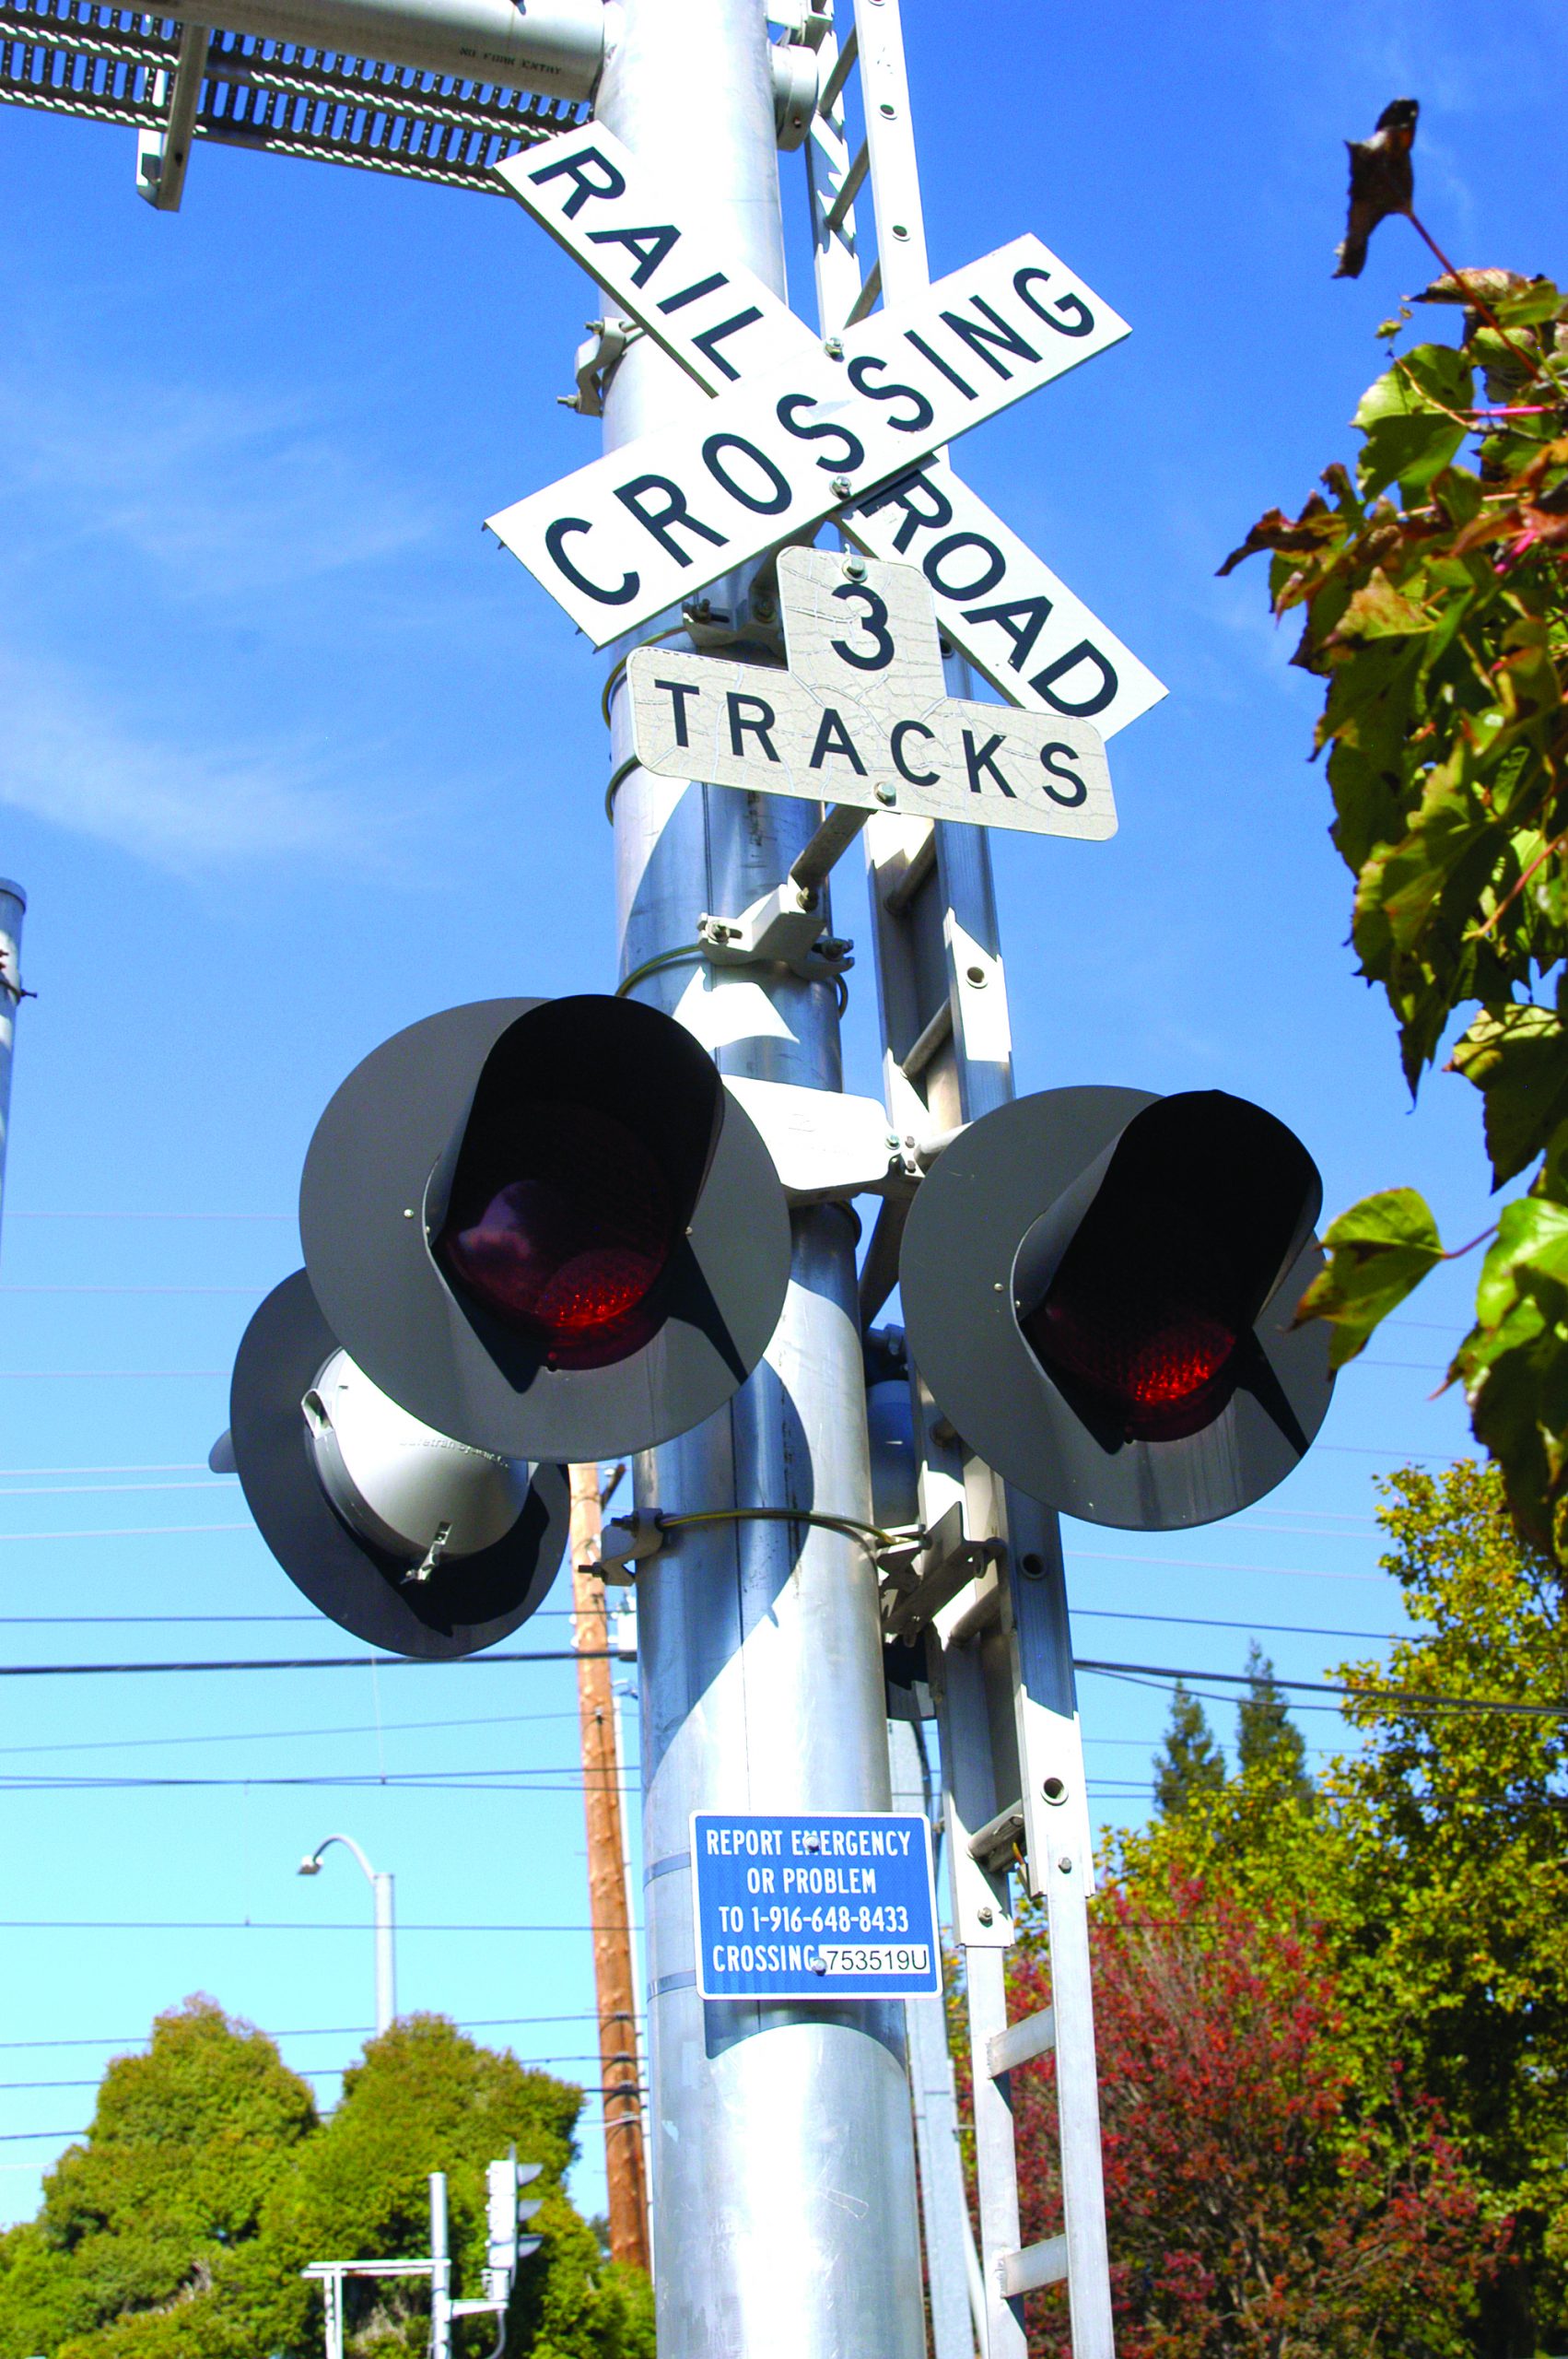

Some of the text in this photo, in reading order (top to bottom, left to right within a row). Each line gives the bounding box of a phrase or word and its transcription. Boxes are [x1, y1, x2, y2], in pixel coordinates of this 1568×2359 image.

[529, 147, 765, 381] RAIL
[544, 267, 1095, 604] CROSSING
[830, 583, 895, 671] 3
[857, 468, 1119, 717] ROAD
[653, 679, 1088, 808] TRACKS
[706, 1829, 782, 1856] REPORT
[746, 1868, 876, 1895] OR PROBLEM
[712, 1944, 928, 1973] CROSSING 753519U
[719, 1906, 908, 1933] TO 1-916-648-8433
